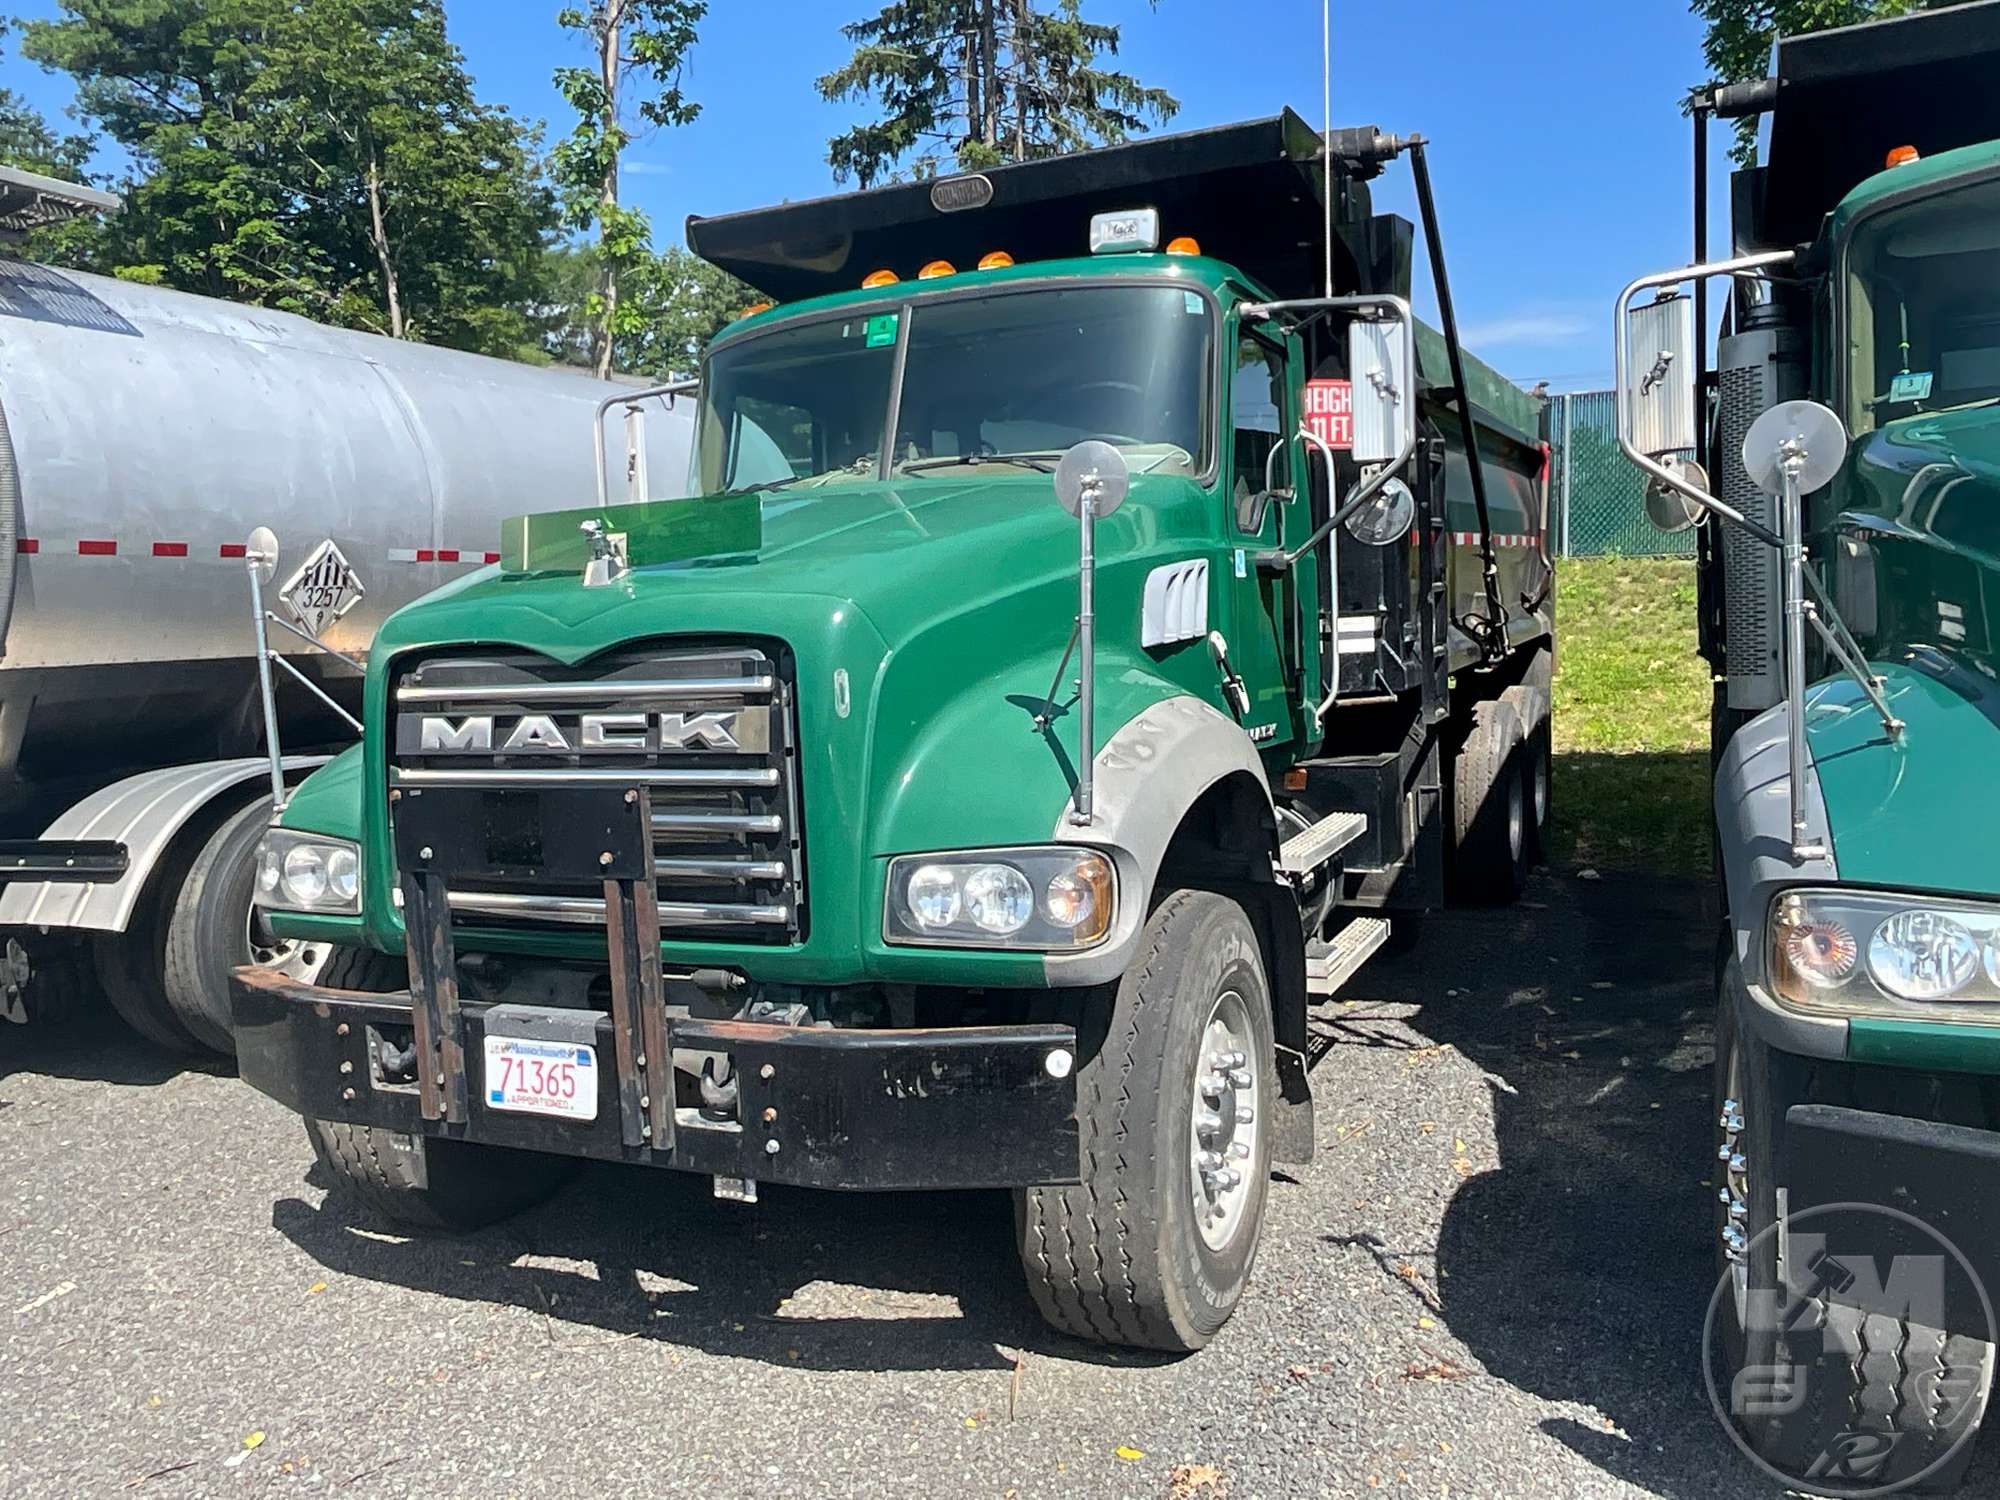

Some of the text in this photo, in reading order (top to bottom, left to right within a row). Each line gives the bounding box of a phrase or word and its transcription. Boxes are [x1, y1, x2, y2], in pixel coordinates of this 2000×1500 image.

[1304, 387, 1352, 414] HEIGH
[1330, 416, 1353, 442] FT.
[303, 586, 344, 609] 3257
[421, 711, 742, 751] MACK
[500, 1056, 576, 1099] 71365
